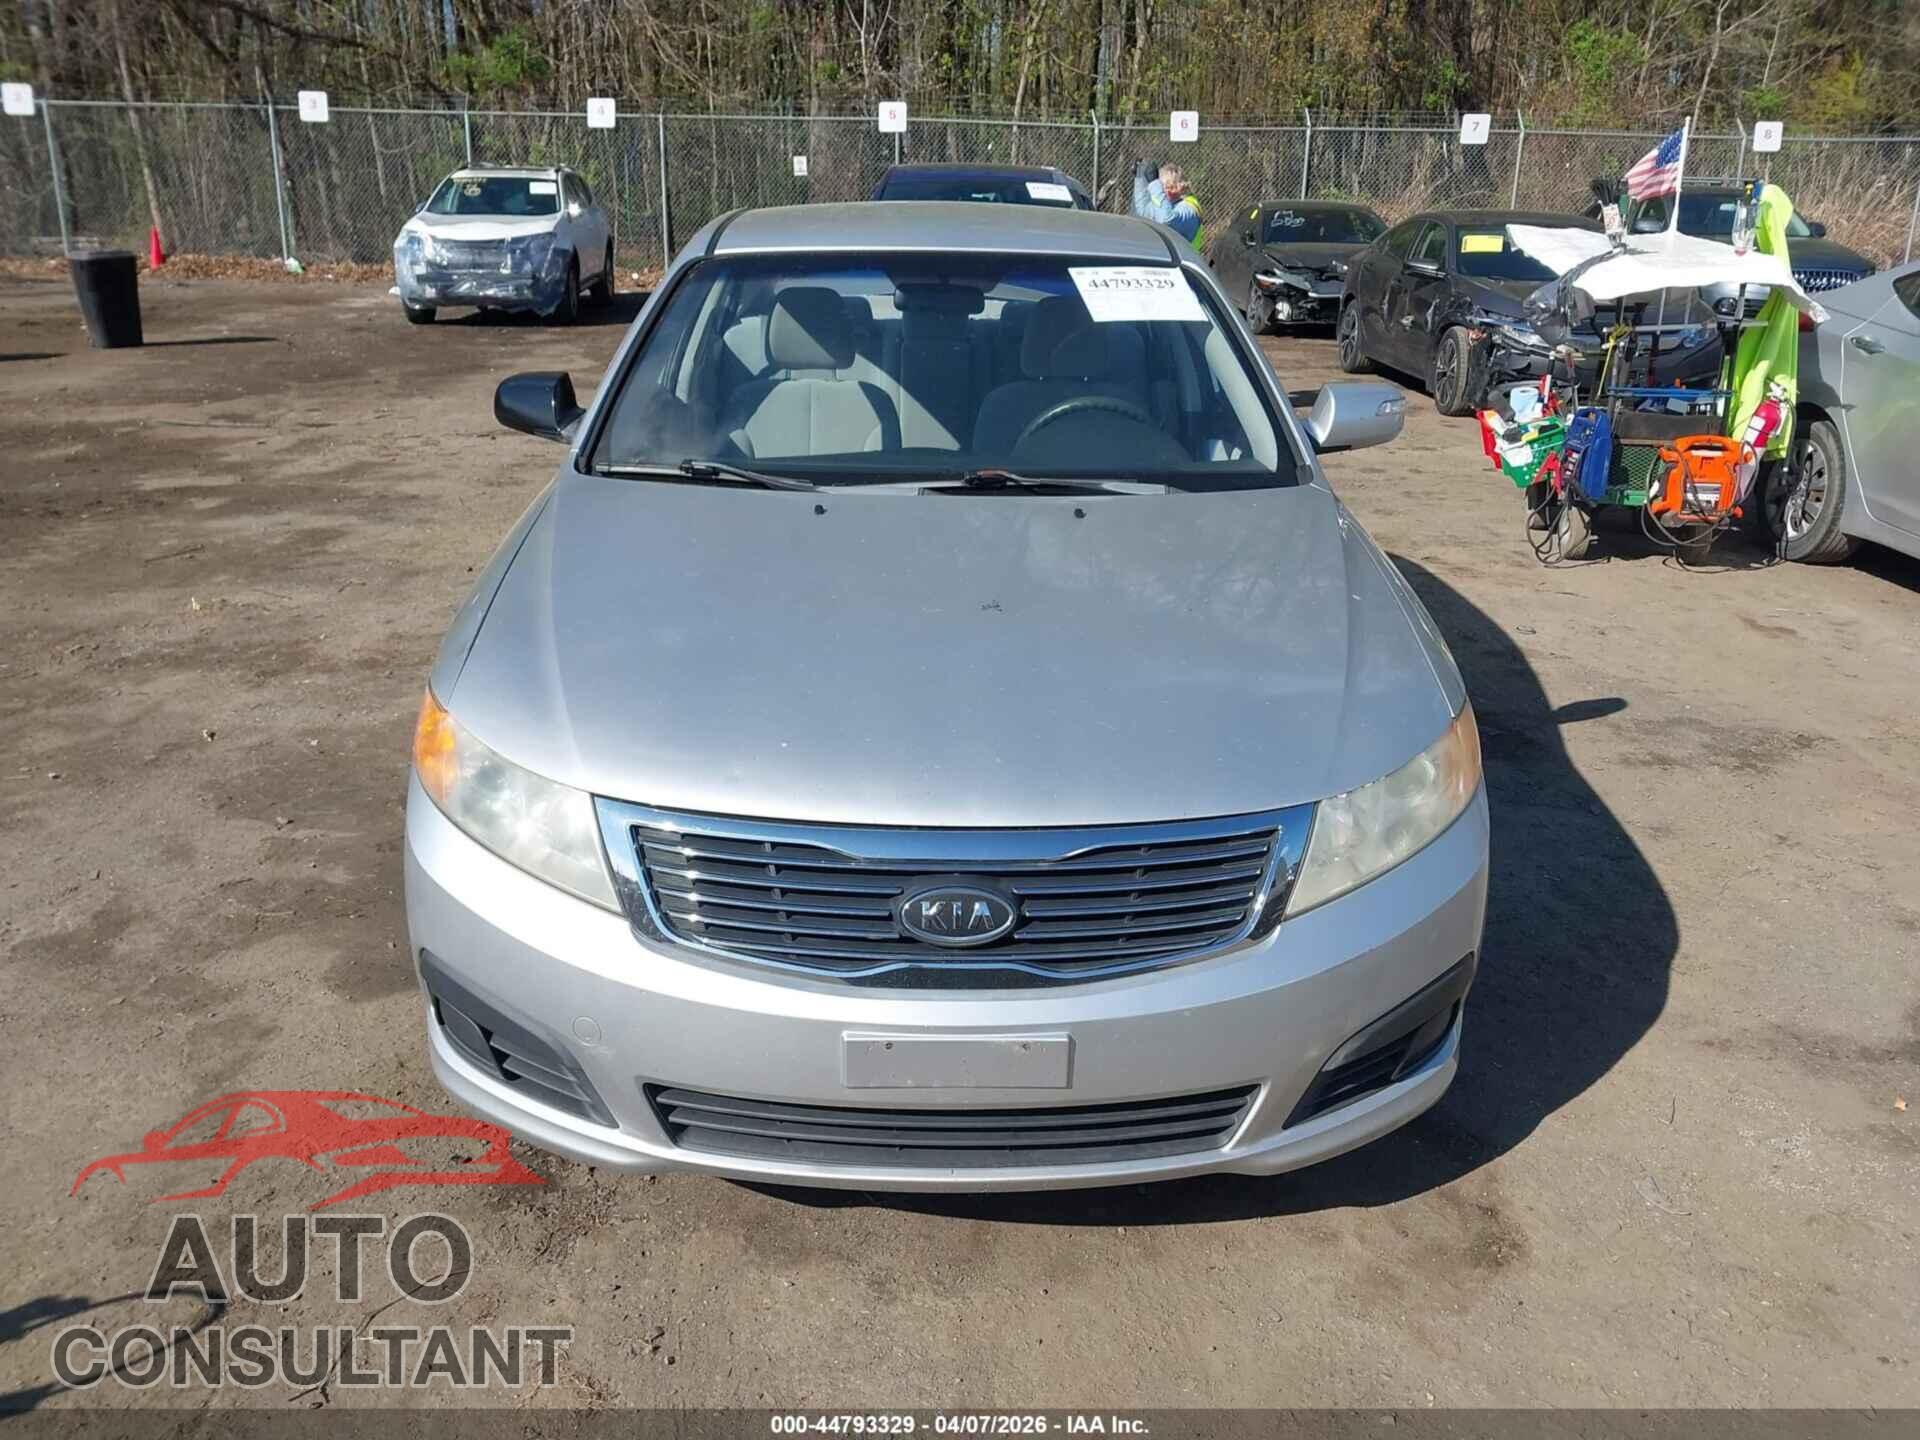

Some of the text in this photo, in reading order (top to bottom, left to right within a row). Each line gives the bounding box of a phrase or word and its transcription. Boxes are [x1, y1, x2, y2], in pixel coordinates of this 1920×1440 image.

[888, 109, 897, 120] 5
[1180, 118, 1189, 129] 6
[1472, 121, 1481, 132] 7
[1763, 128, 1773, 140] 8
[1088, 278, 1175, 289] 44793329
[919, 900, 995, 930] KIA
